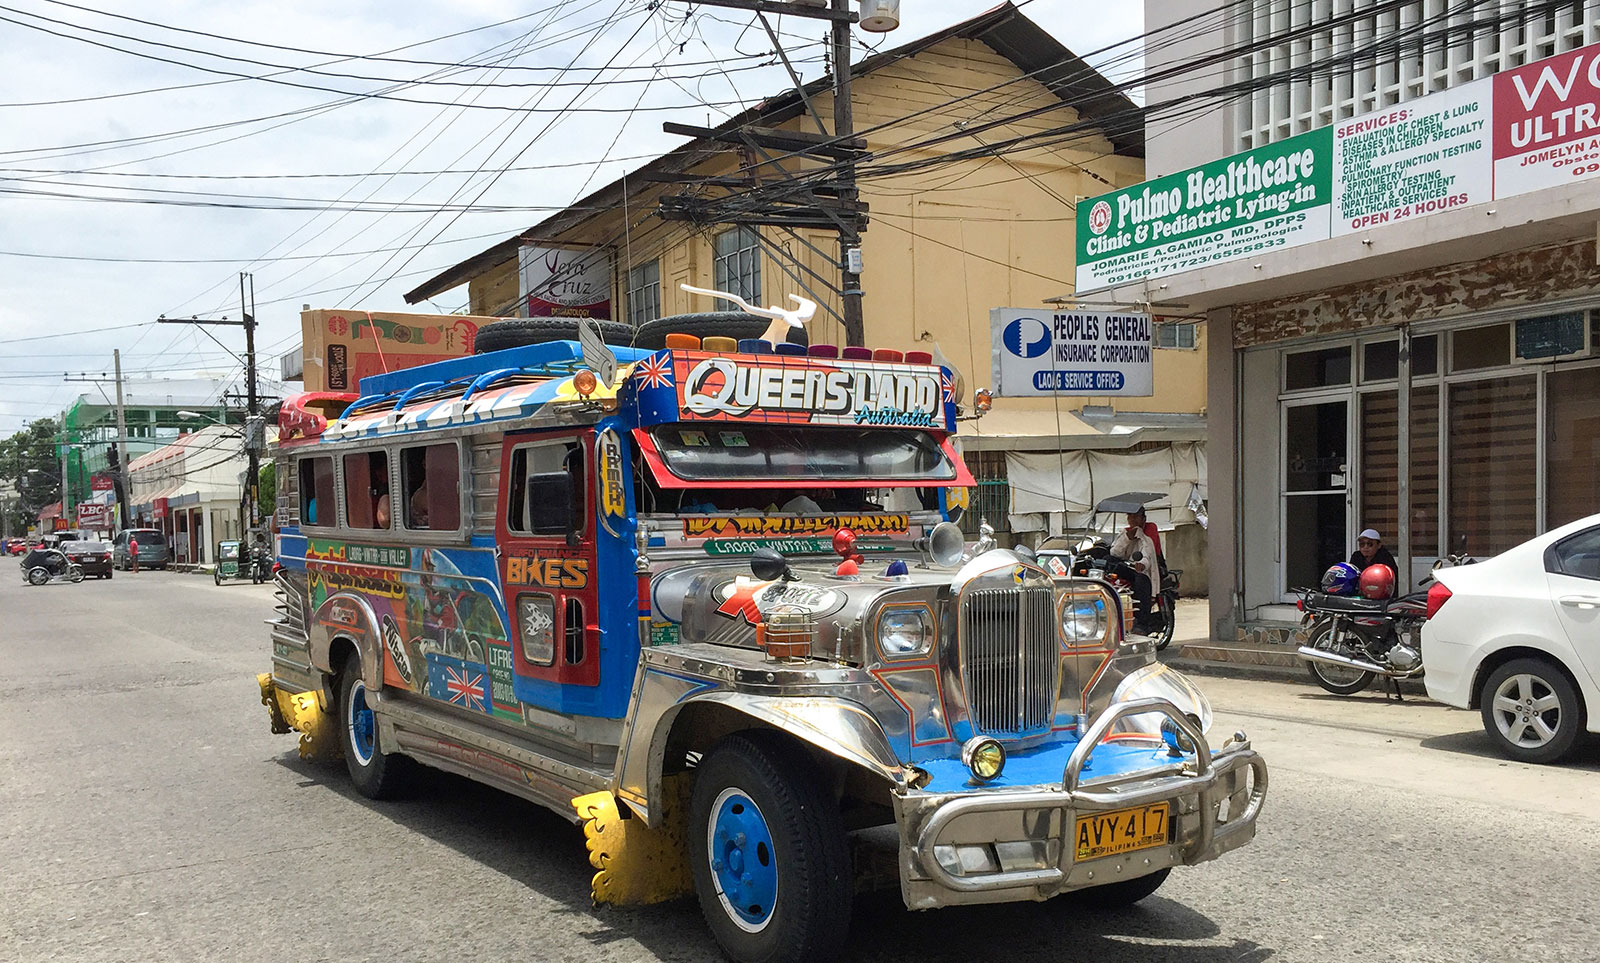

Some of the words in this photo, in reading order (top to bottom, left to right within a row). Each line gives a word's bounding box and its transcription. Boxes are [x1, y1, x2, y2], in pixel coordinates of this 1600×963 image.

[1337, 108, 1413, 139] SERVICES:
[1342, 127, 1395, 148] EVALUATION
[1396, 123, 1408, 134] OF
[1410, 113, 1441, 132] CHEST
[1443, 110, 1450, 120] &
[1452, 102, 1479, 118] LUNG
[1342, 138, 1384, 158] DISEASES
[1386, 135, 1396, 146] IN
[1397, 121, 1443, 144] CHILDREN
[1510, 102, 1600, 148] ULTR
[1342, 151, 1378, 167] ASTHMA
[1380, 147, 1387, 157] &
[1388, 135, 1430, 154] ALLERGY
[1432, 119, 1485, 142] SPECIALTY
[1520, 142, 1585, 167] JOMELYN
[1341, 163, 1392, 185] PULMONARY
[1394, 151, 1440, 171] FUNCTION
[1442, 139, 1482, 159] TESTING
[1343, 160, 1372, 175] CLINIC
[1117, 185, 1182, 229] Pulmo
[1186, 148, 1315, 210] Healthcare
[1341, 188, 1362, 202] SKIN
[1363, 179, 1399, 198] ALLERGY
[1401, 169, 1441, 187] TESTING
[1341, 193, 1386, 211] INPATIENT
[1388, 189, 1395, 199] &
[1398, 175, 1456, 197] OUTPATIENT
[1086, 230, 1131, 256] Clinic
[1134, 224, 1149, 244] &
[1151, 203, 1231, 240] Pediatric
[1235, 182, 1316, 220] Lying-in
[1342, 197, 1400, 220] HEALTHCARE
[1402, 187, 1448, 206] SERVICES
[1351, 211, 1390, 229] OPEN
[1393, 206, 1411, 220] 24
[1415, 193, 1469, 215] HOURS
[1091, 251, 1149, 272] JOMARIE
[1153, 232, 1224, 257] A.GAMIAO
[1231, 223, 1259, 238] MD,
[1264, 212, 1307, 230] DPPS
[1216, 224, 1303, 250] Pulmonologist
[545, 250, 587, 276] Vera
[1107, 237, 1287, 284] 09166171723/6555833
[548, 281, 592, 298] Cruz
[1053, 314, 1099, 341] PEOPLES
[1105, 316, 1151, 342] GENERAL
[1055, 344, 1097, 363] INSURANCE
[1100, 345, 1150, 363] CORPORATION
[1064, 373, 1094, 389] SERVICE
[1096, 373, 1121, 388] OFFICE
[854, 405, 938, 427] Australia
[80, 505, 104, 515] LBC
